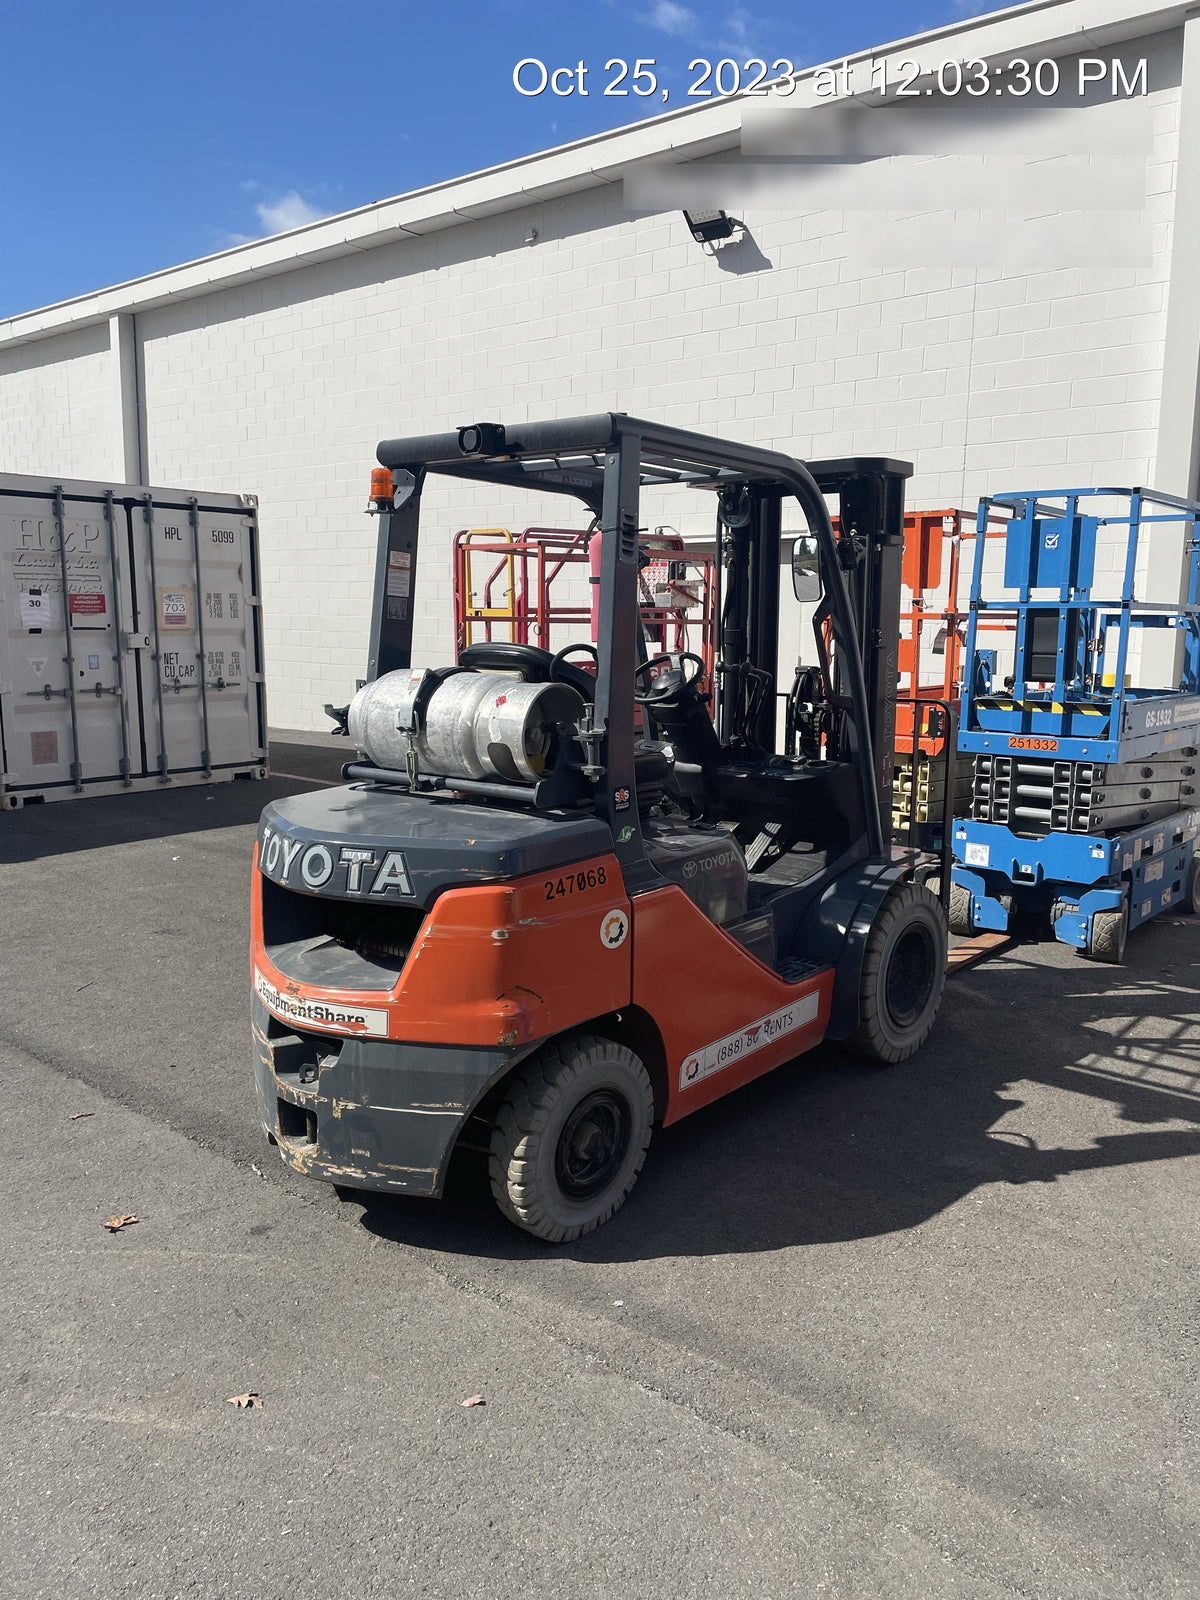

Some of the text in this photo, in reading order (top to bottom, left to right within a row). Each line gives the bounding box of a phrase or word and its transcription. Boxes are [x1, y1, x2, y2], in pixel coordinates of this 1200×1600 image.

[164, 527, 235, 544] HPL 5099
[29, 600, 41, 608] 30
[164, 603, 186, 613] 703
[163, 652, 179, 665] NET
[1145, 709, 1172, 728] GS-1932
[1010, 737, 1058, 751] 251332
[614, 789, 630, 803] SAS
[260, 826, 417, 898] TOYOTA
[698, 850, 738, 873] TOYOTA
[544, 867, 607, 901] 247068
[717, 1036, 744, 1064] (888)
